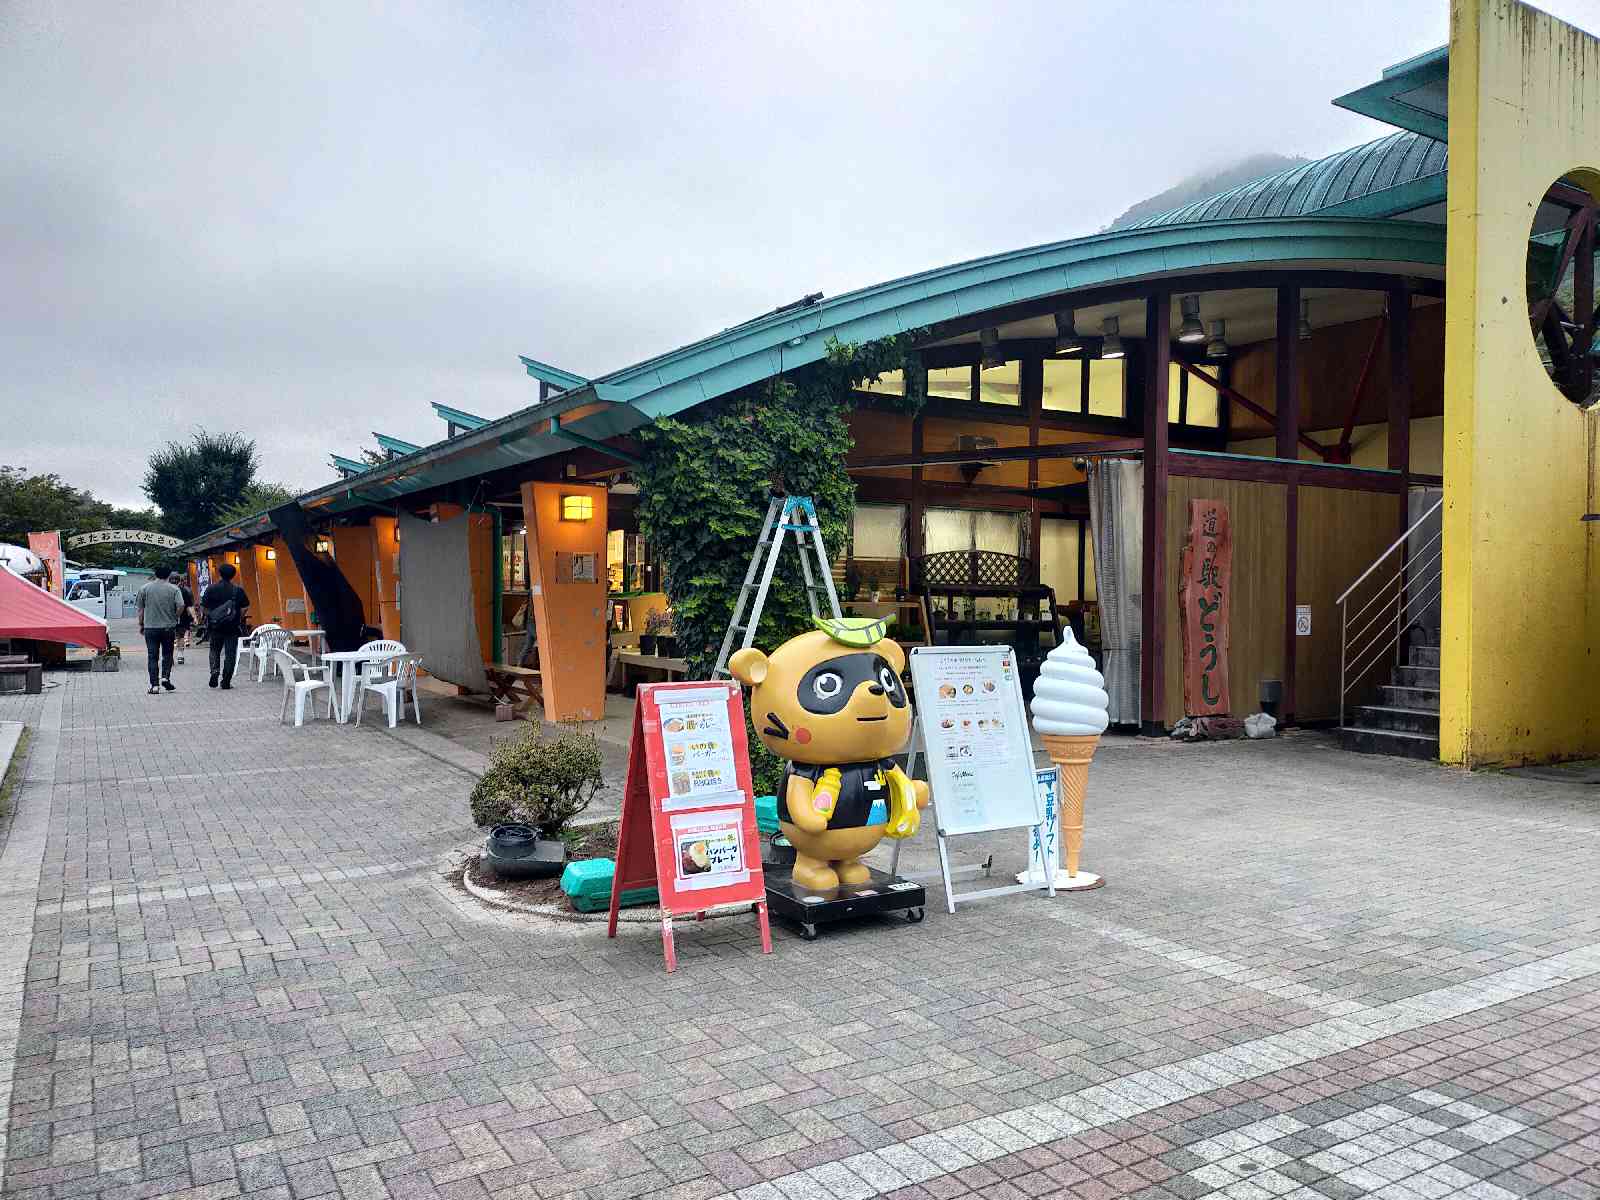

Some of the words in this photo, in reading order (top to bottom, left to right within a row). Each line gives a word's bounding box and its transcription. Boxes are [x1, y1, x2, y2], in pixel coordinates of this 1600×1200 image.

[76, 531, 178, 546] またおこしください
[1197, 508, 1223, 706] 道の駅どうし
[1045, 792, 1056, 858] 豆乳ソフト
